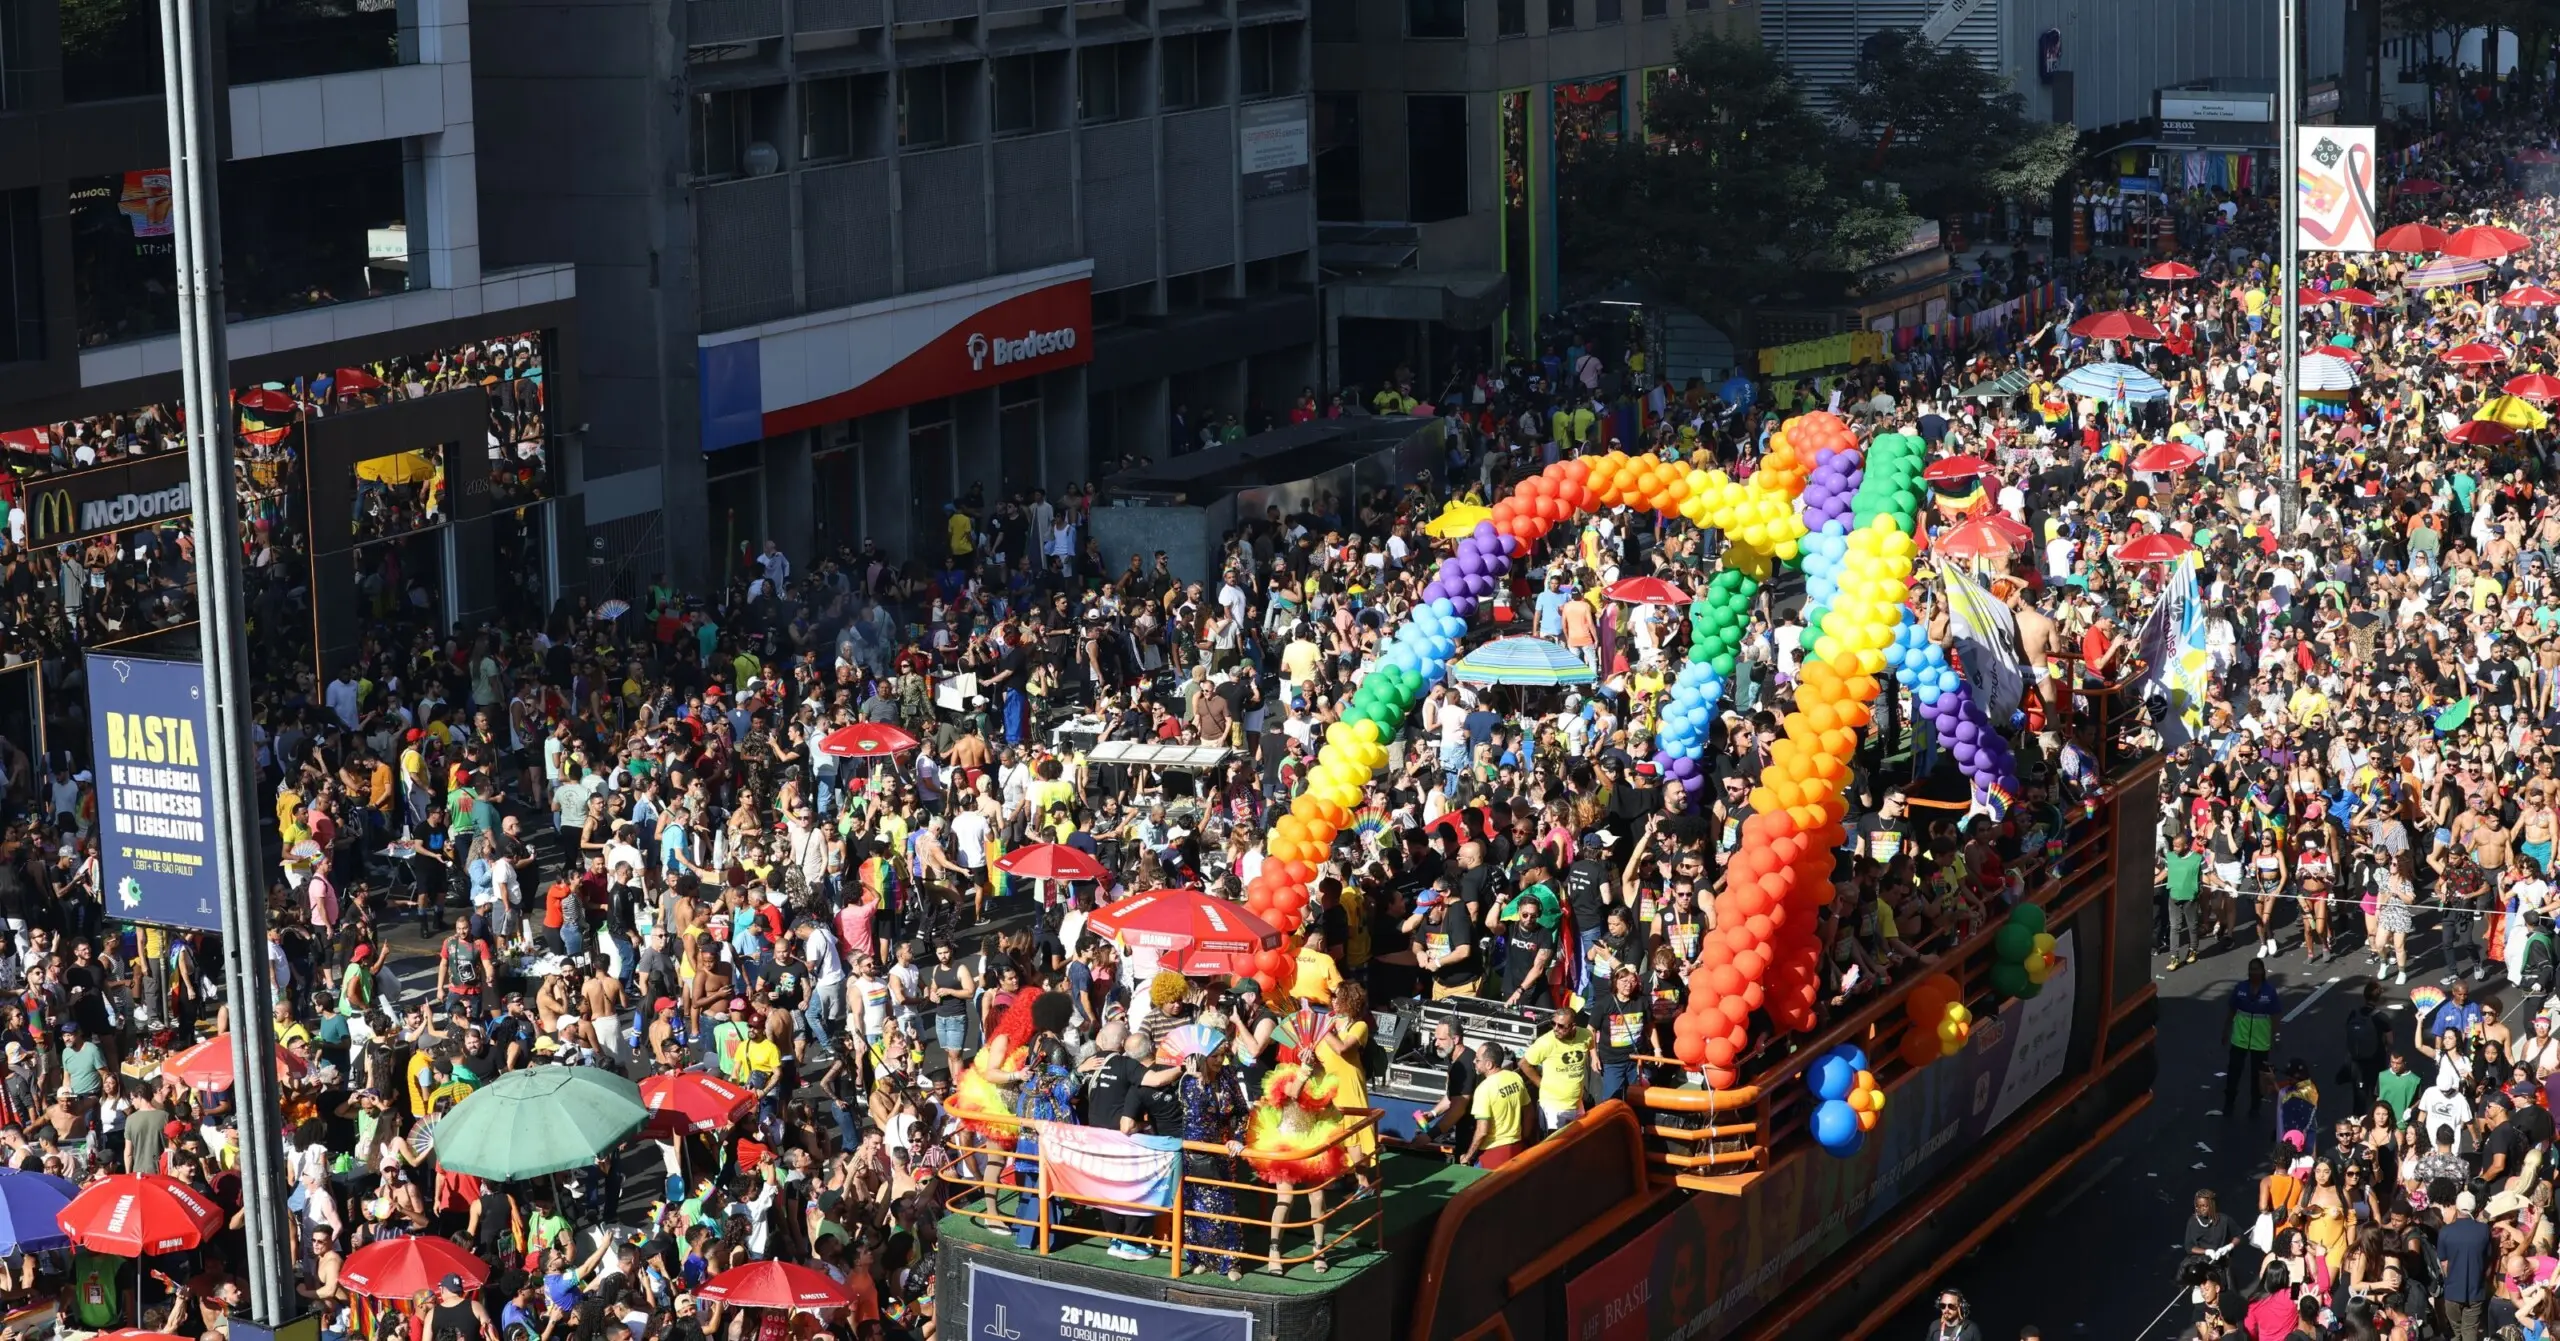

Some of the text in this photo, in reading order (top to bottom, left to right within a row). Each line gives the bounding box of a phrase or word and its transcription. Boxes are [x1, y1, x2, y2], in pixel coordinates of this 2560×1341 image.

[2162, 121, 2196, 129] XEROX
[993, 326, 1076, 366] Bradesco
[106, 712, 199, 767] BASTA
[111, 764, 201, 793] DE NEGLIGÊNCIA
[113, 788, 202, 818] E RETROCESSO
[115, 813, 204, 842] NO LEGISLATIVO
[133, 860, 193, 877] LGBT+ DE SÃO PAULO
[1499, 1081, 1520, 1098] STAFF
[108, 1194, 135, 1233] BRAHMA
[167, 1184, 207, 1218] BRAHMA
[158, 1237, 183, 1249] BRAHMA
[800, 1292, 829, 1300] AMSTEL
[1604, 1277, 1652, 1330] BRASIL
[1060, 1325, 1072, 1337] DO
[1084, 1309, 1139, 1336] PARADA
